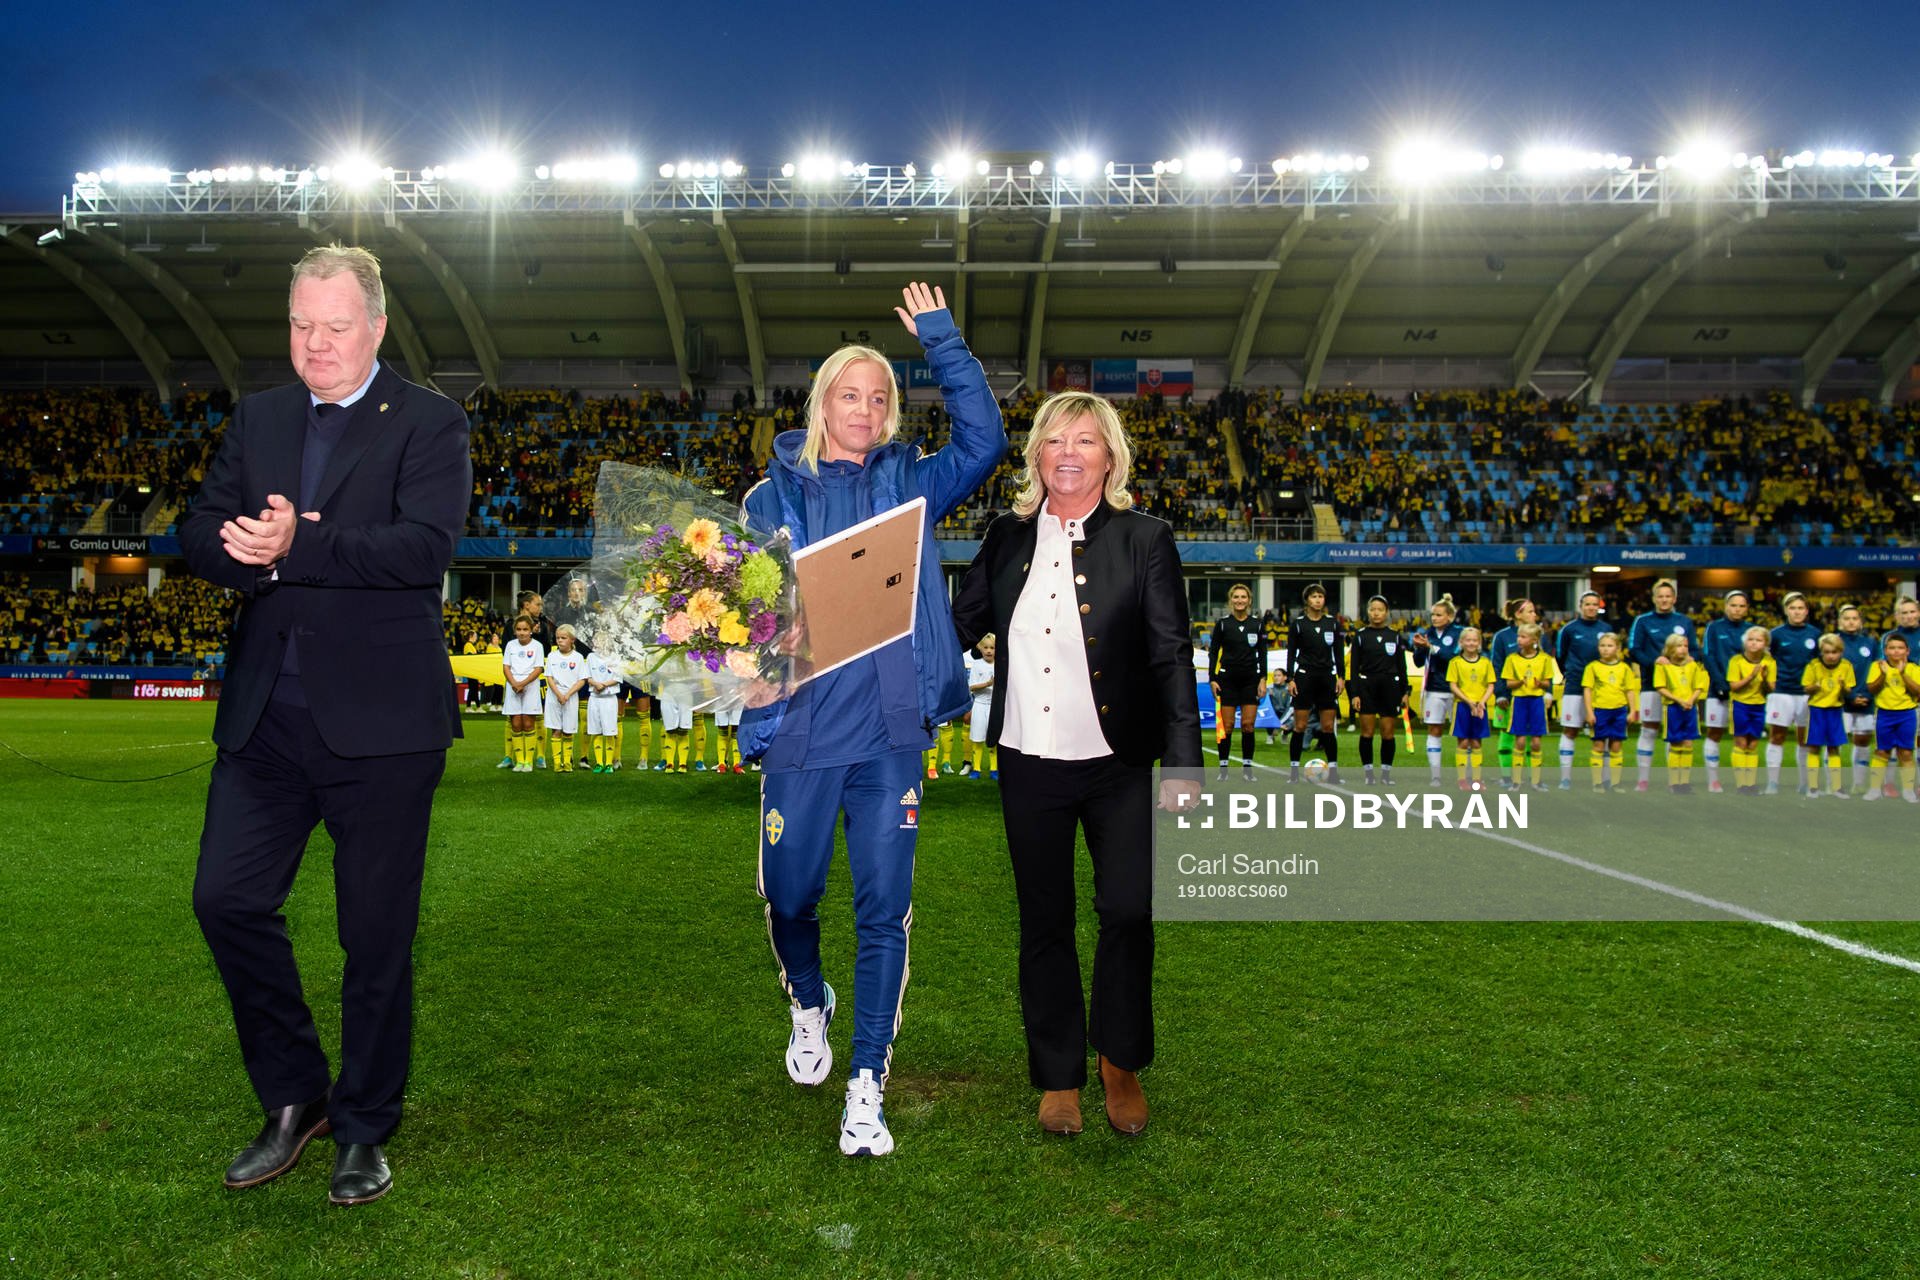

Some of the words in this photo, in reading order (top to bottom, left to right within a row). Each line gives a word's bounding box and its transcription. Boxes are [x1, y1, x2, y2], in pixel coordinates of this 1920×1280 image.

[570, 331, 600, 343] L4
[840, 330, 870, 343] L5
[1120, 330, 1152, 342] N5
[1403, 329, 1437, 341] N4
[69, 539, 109, 550] Gamla
[112, 539, 146, 550] Ullevi
[141, 684, 160, 697] för
